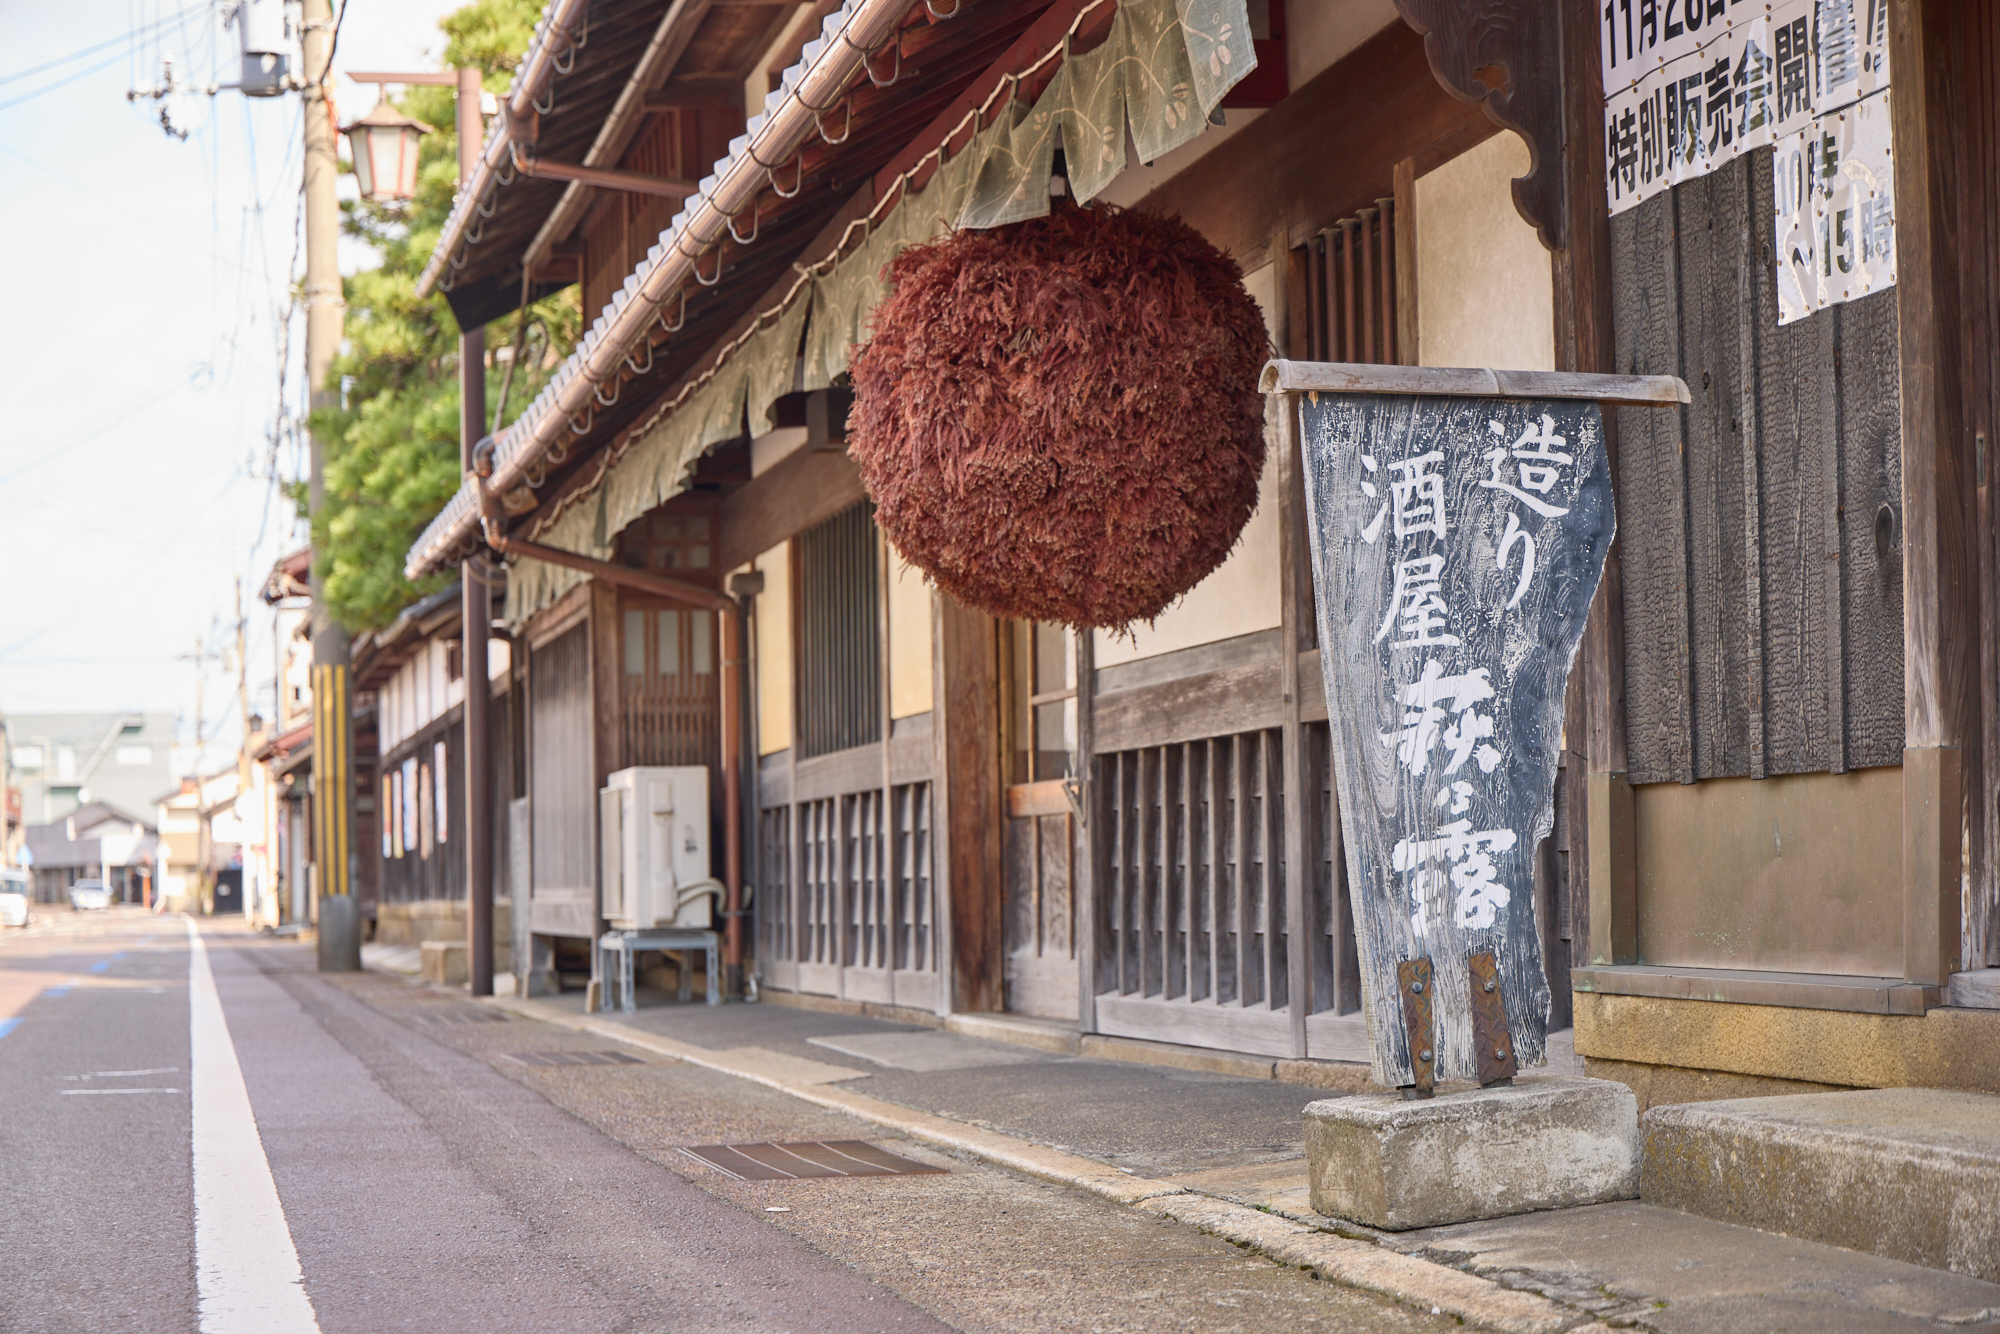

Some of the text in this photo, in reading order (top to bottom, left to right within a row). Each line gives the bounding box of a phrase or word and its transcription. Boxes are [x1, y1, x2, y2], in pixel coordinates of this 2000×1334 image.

[1778, 131, 1838, 218] 10時
[1361, 450, 1461, 650] 酒屋
[1479, 414, 1574, 611] 造り
